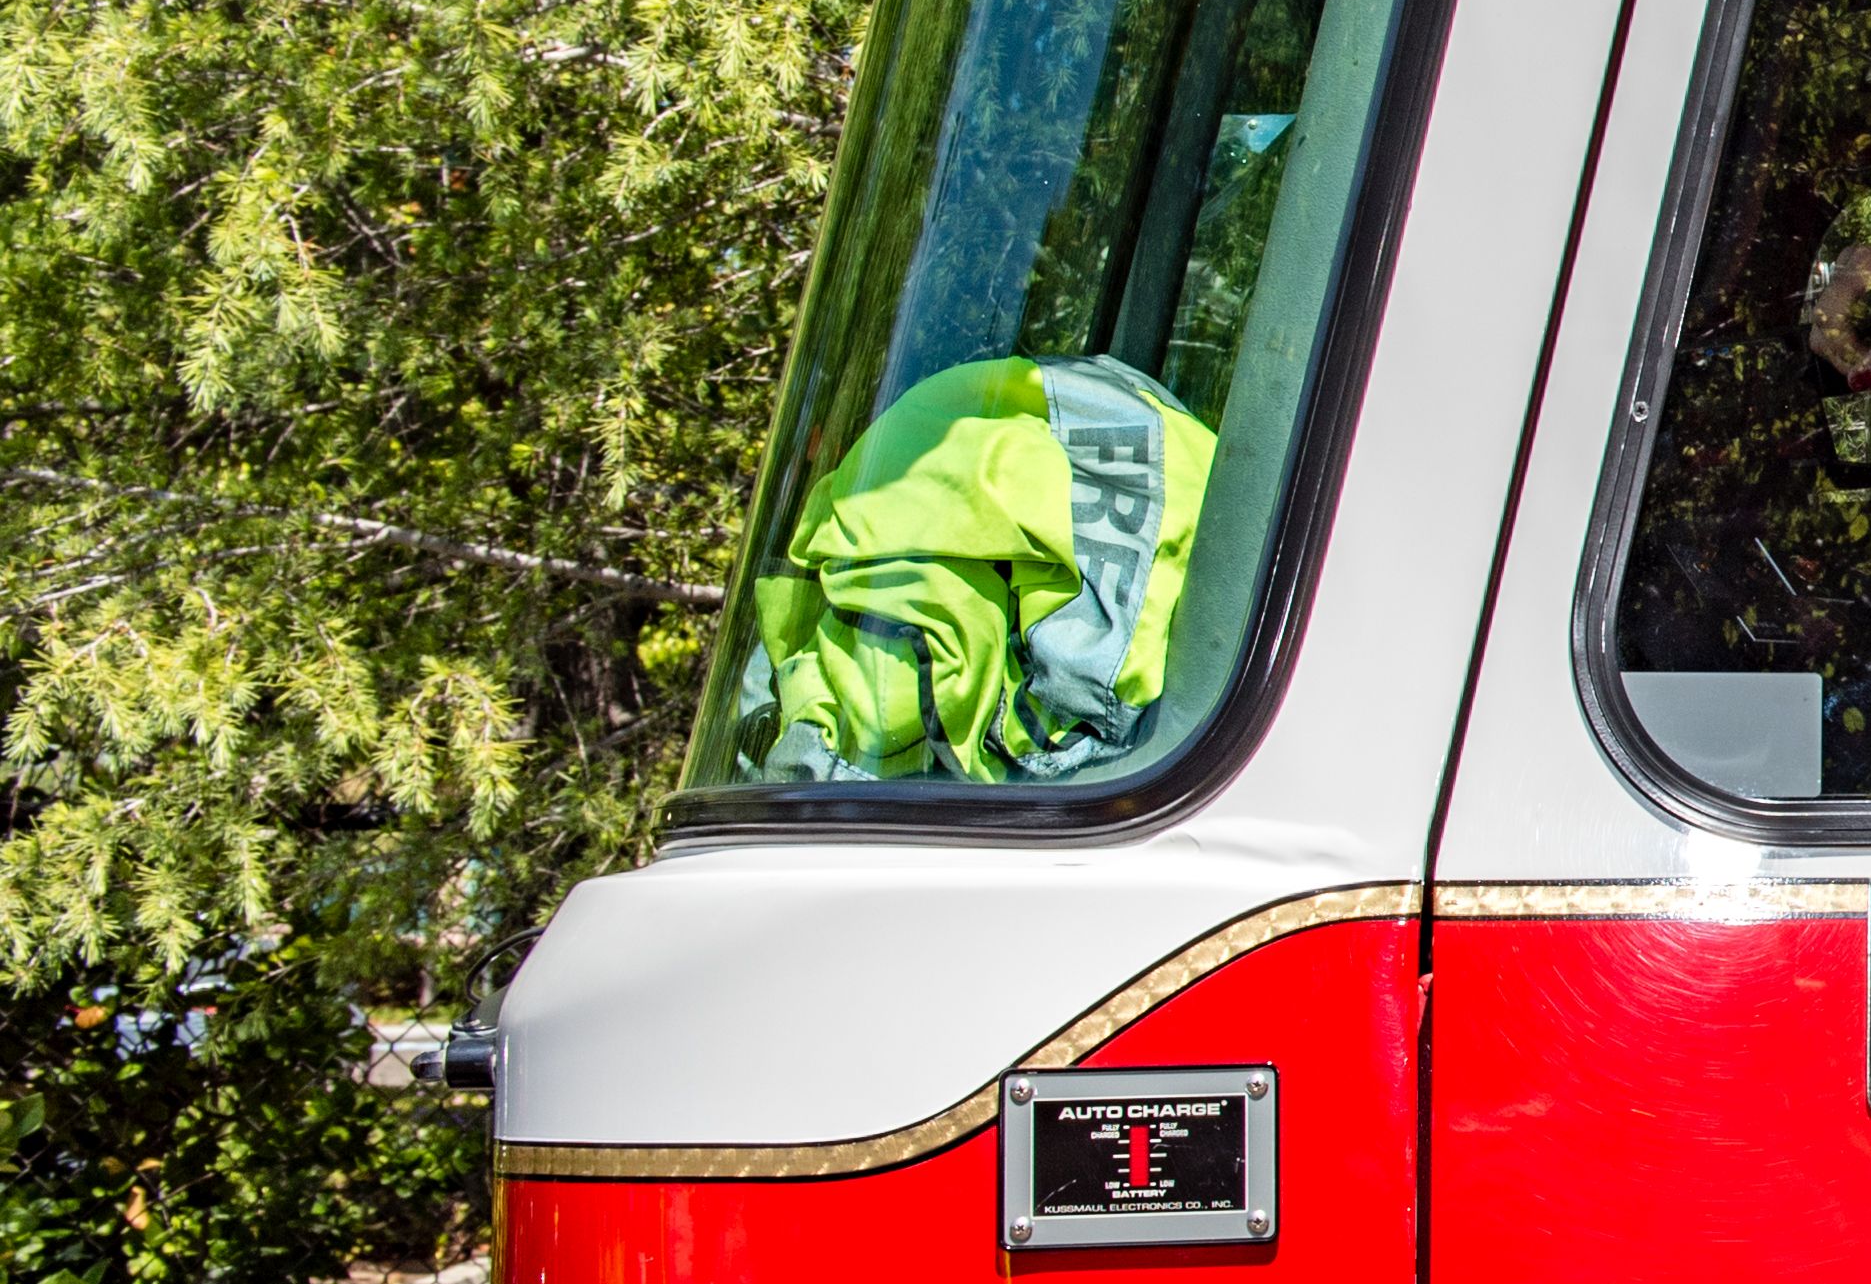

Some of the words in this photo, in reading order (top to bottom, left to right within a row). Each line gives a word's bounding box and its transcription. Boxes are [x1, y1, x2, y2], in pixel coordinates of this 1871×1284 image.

[1058, 1105, 1123, 1120] AUTO
[1127, 1102, 1221, 1118] CHARGE
[1105, 1181, 1120, 1190] LOW
[1159, 1180, 1175, 1188] LOW
[1112, 1189, 1166, 1199] BATTERY
[1044, 1204, 1106, 1214] KUSSMAUL
[1110, 1202, 1182, 1212] ELECTRONICS
[1211, 1200, 1234, 1209] INC.
